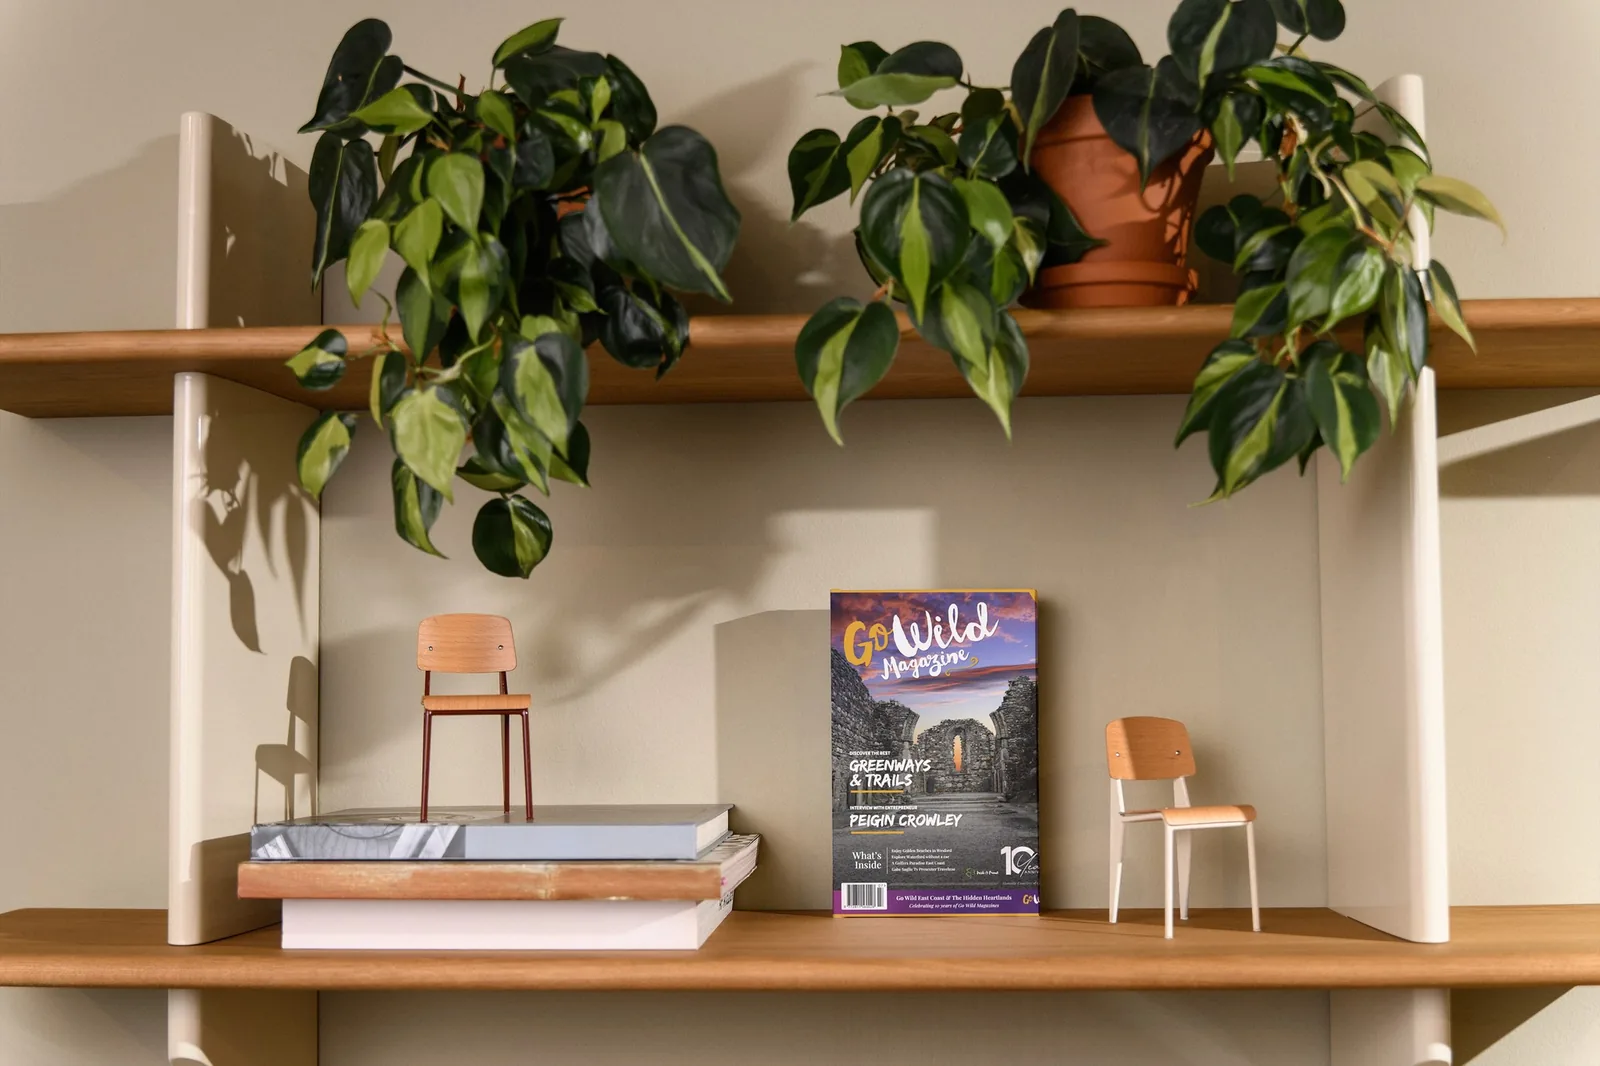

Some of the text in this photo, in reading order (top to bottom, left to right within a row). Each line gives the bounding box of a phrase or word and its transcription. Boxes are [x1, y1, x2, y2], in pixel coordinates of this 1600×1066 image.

[892, 601, 999, 658] Wild
[881, 648, 970, 680] Magazine
[849, 758, 932, 773] GREENWAYS
[849, 773, 913, 788] & TRAILS
[849, 812, 963, 828] PEIGIN CROWLEY
[852, 851, 882, 860] What's
[1000, 845, 1035, 876] 10
[855, 860, 882, 870] Inside
